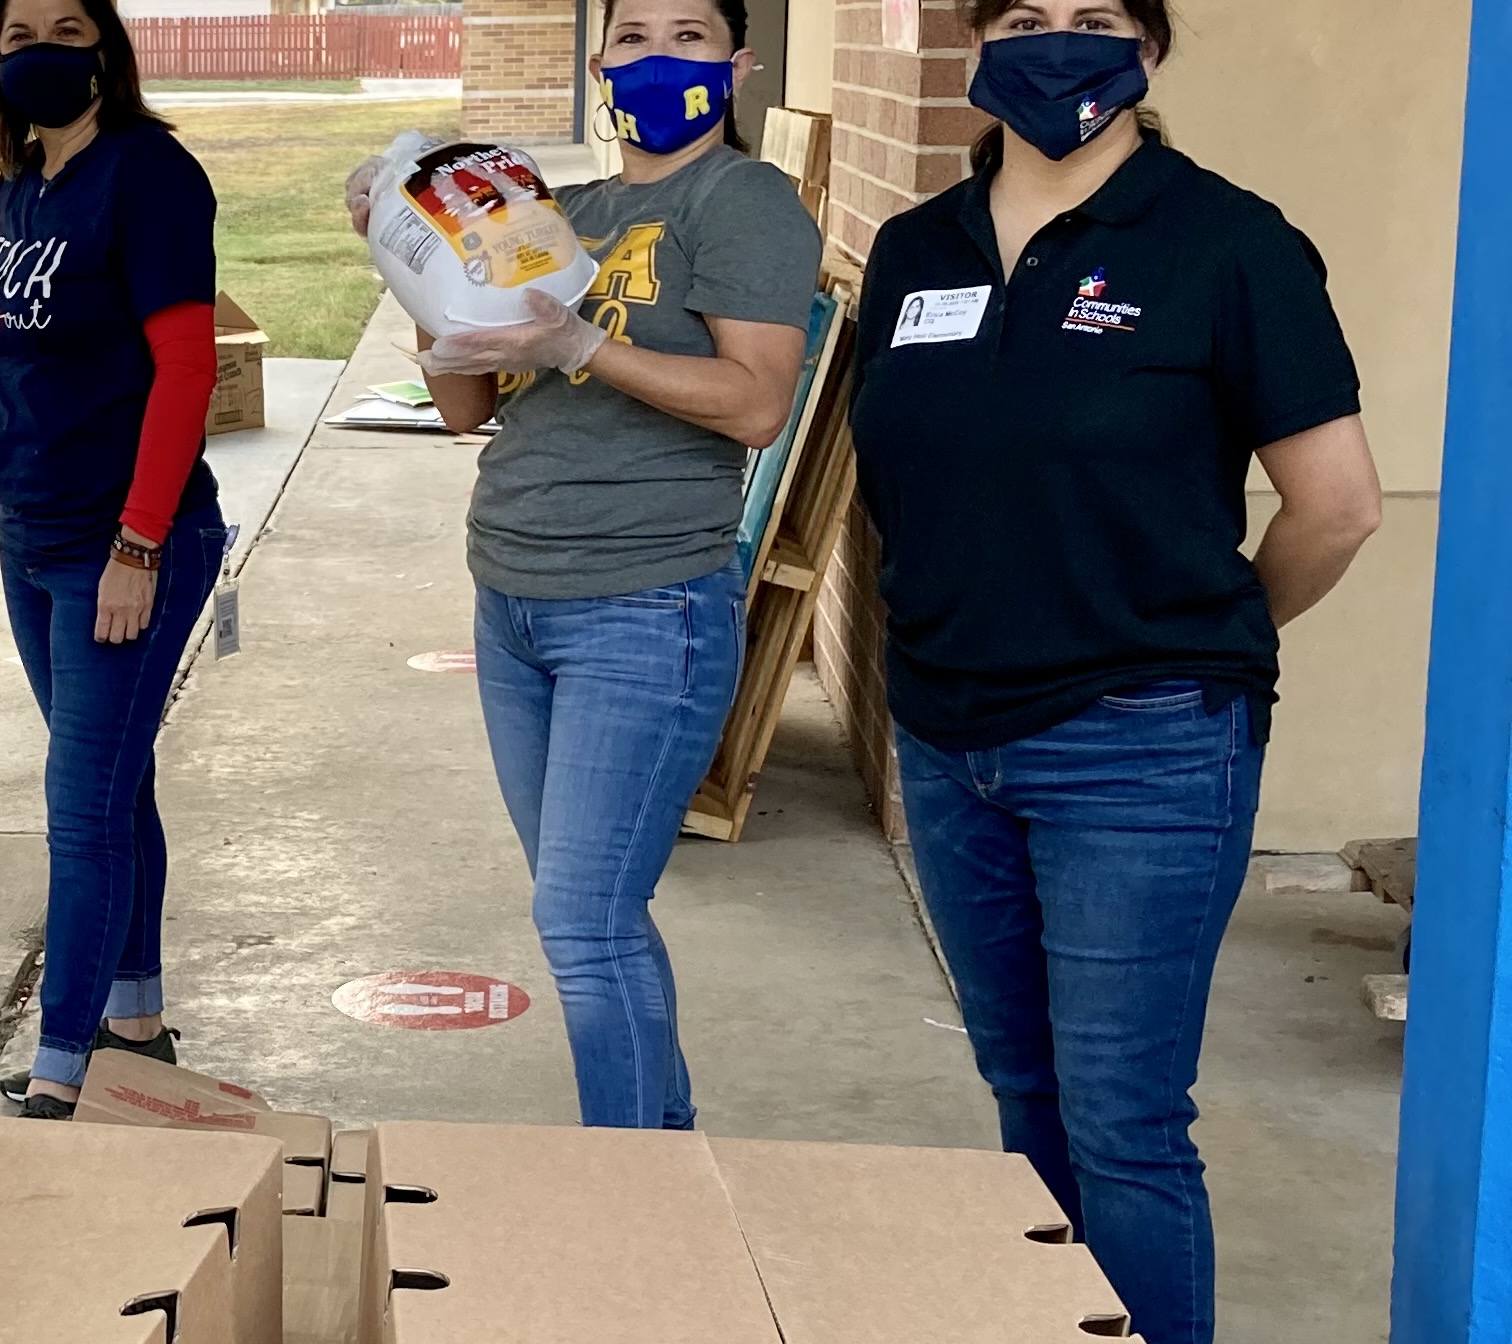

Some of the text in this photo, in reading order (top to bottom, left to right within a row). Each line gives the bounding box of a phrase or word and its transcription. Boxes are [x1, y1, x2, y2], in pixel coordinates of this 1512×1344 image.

[683, 85, 711, 120] R
[614, 108, 642, 143] H
[940, 291, 978, 301] VISITOR
[1073, 296, 1142, 316] Communities
[0, 298, 52, 330] out
[1079, 308, 1122, 324] Schools
